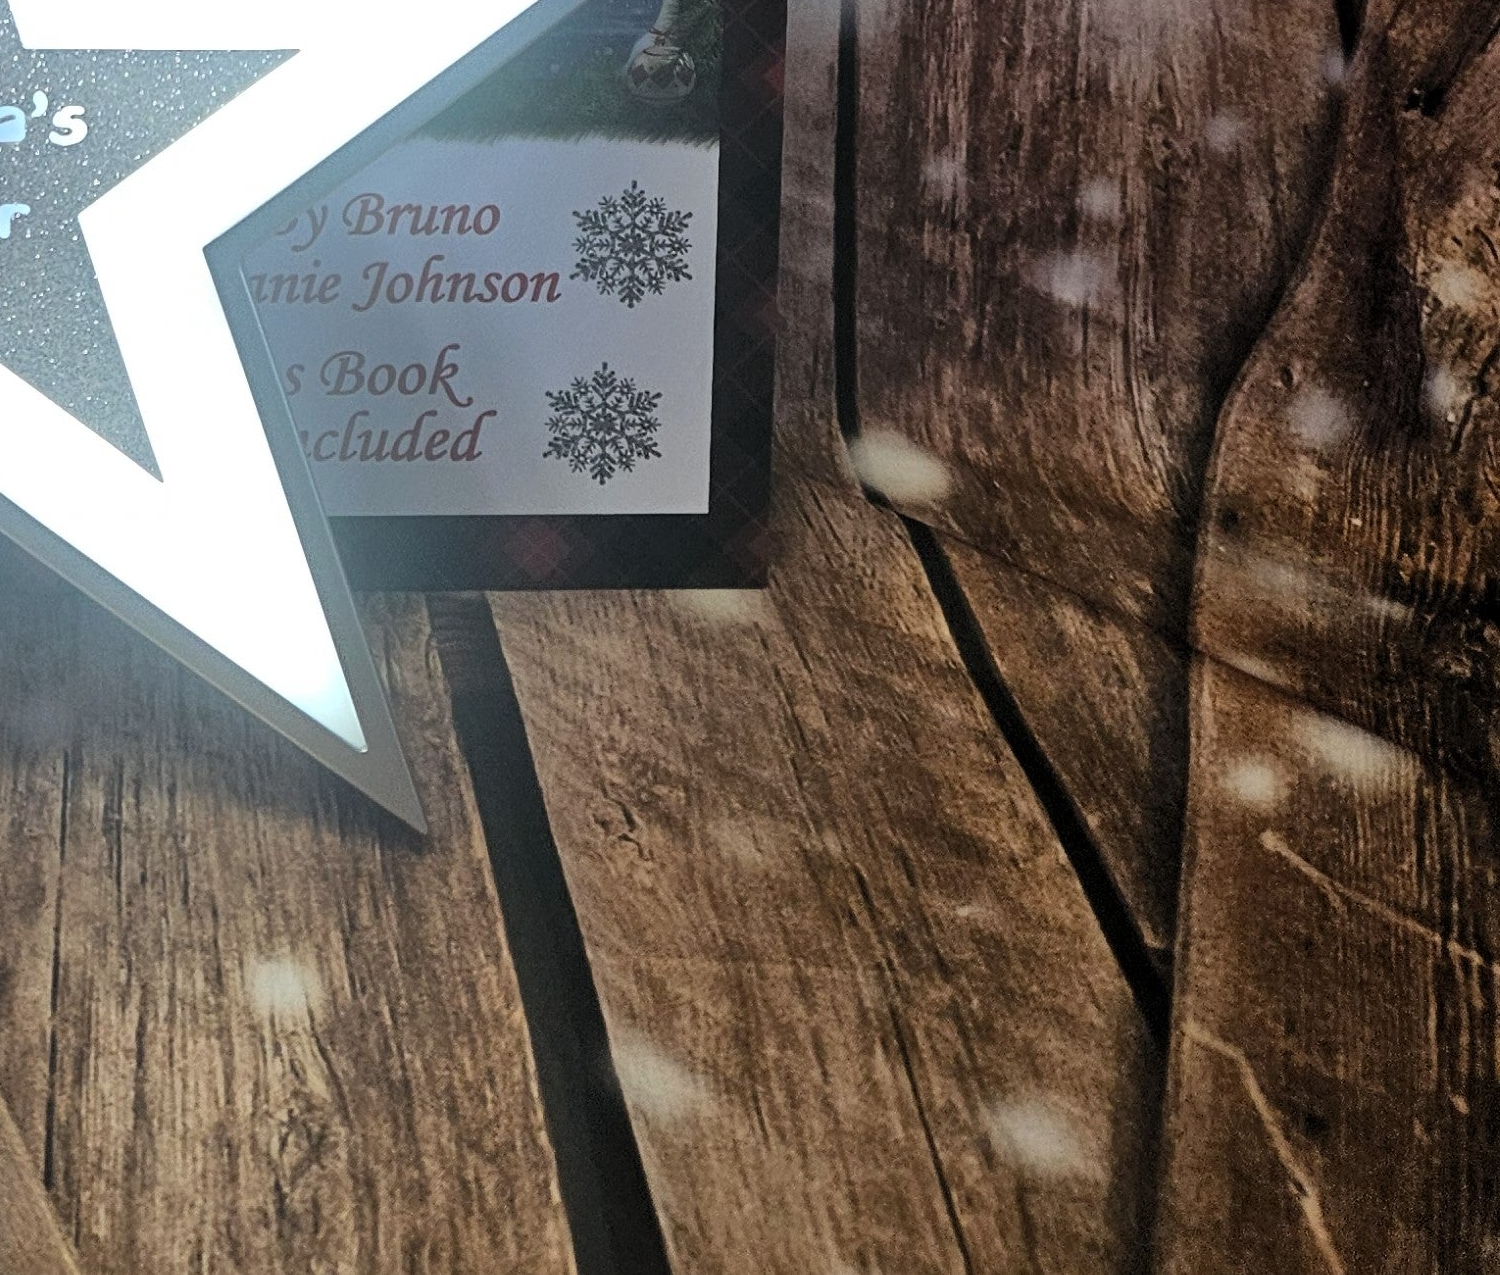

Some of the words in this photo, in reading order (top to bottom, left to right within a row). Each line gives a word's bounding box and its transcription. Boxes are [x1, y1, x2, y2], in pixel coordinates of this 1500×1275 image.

[341, 191, 501, 237] Bruno
[350, 254, 563, 312] Johnson
[319, 342, 475, 408] Book
